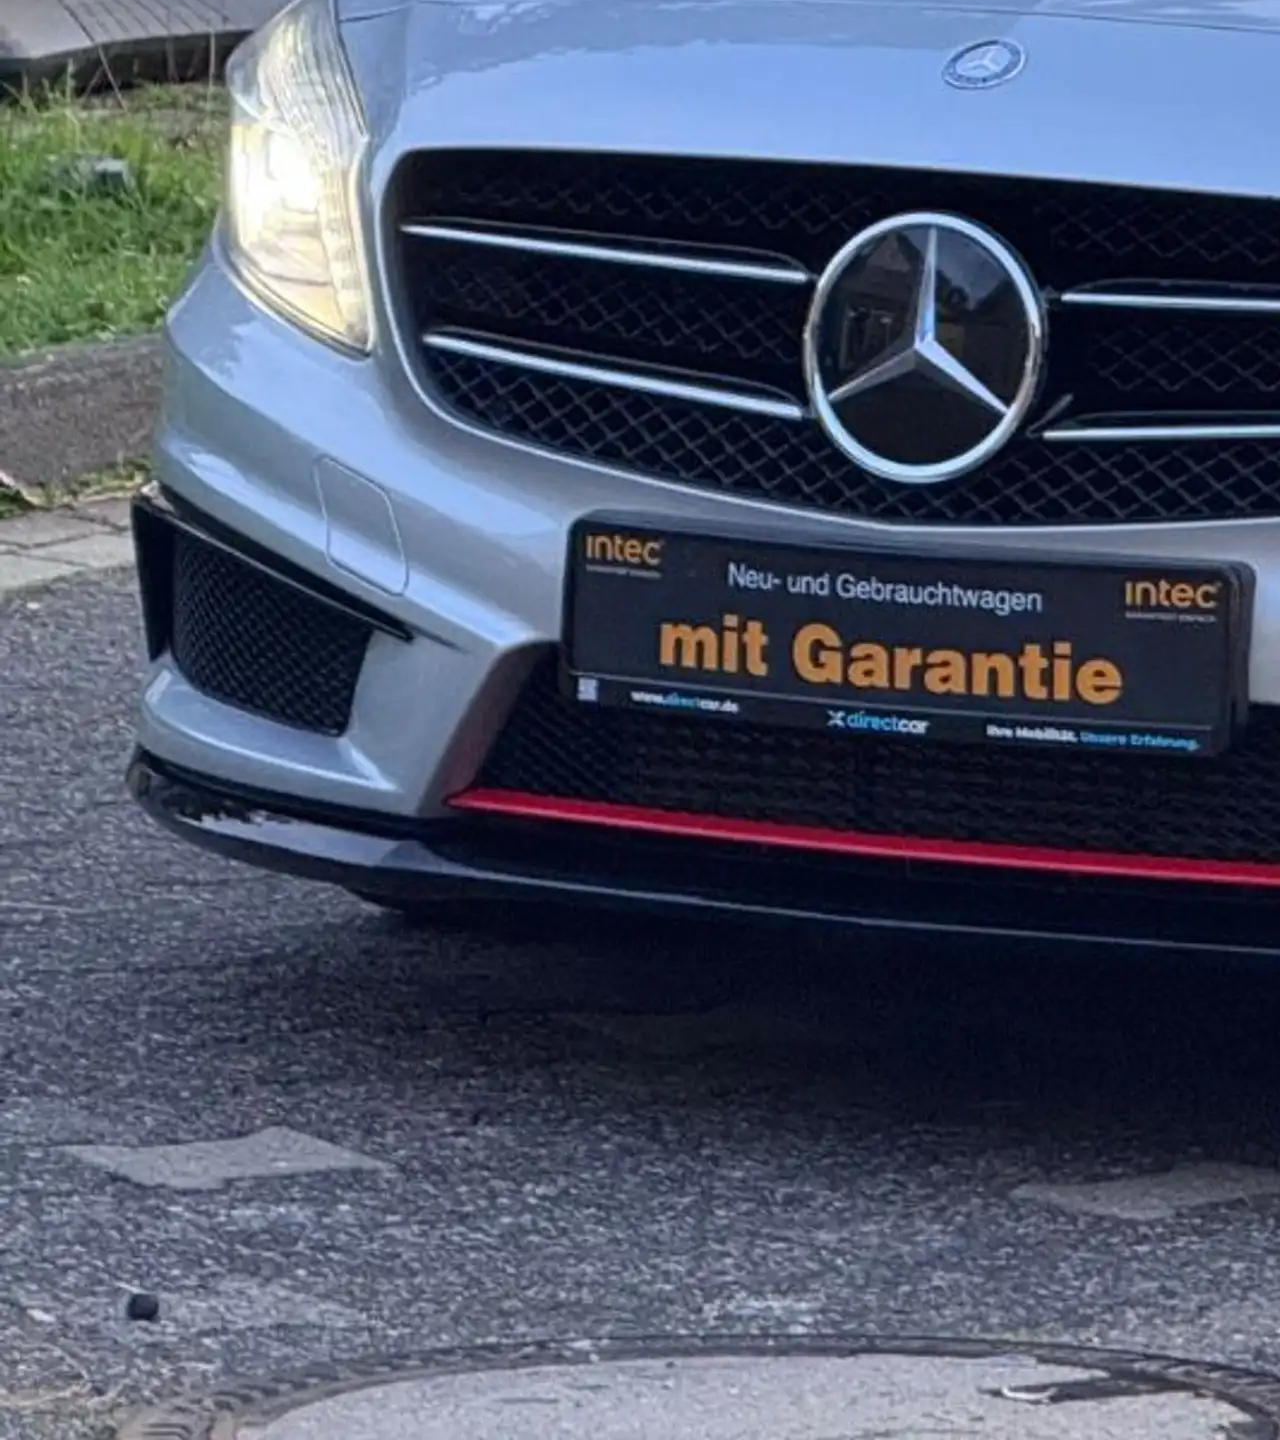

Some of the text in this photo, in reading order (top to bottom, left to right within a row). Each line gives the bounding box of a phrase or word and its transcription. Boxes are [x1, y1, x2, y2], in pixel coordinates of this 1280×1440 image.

[586, 534, 662, 566] intec
[728, 563, 1042, 616] Neu- und Gebrauchtwagen
[1125, 578, 1219, 609] intec
[659, 614, 1123, 705] mit Garantie
